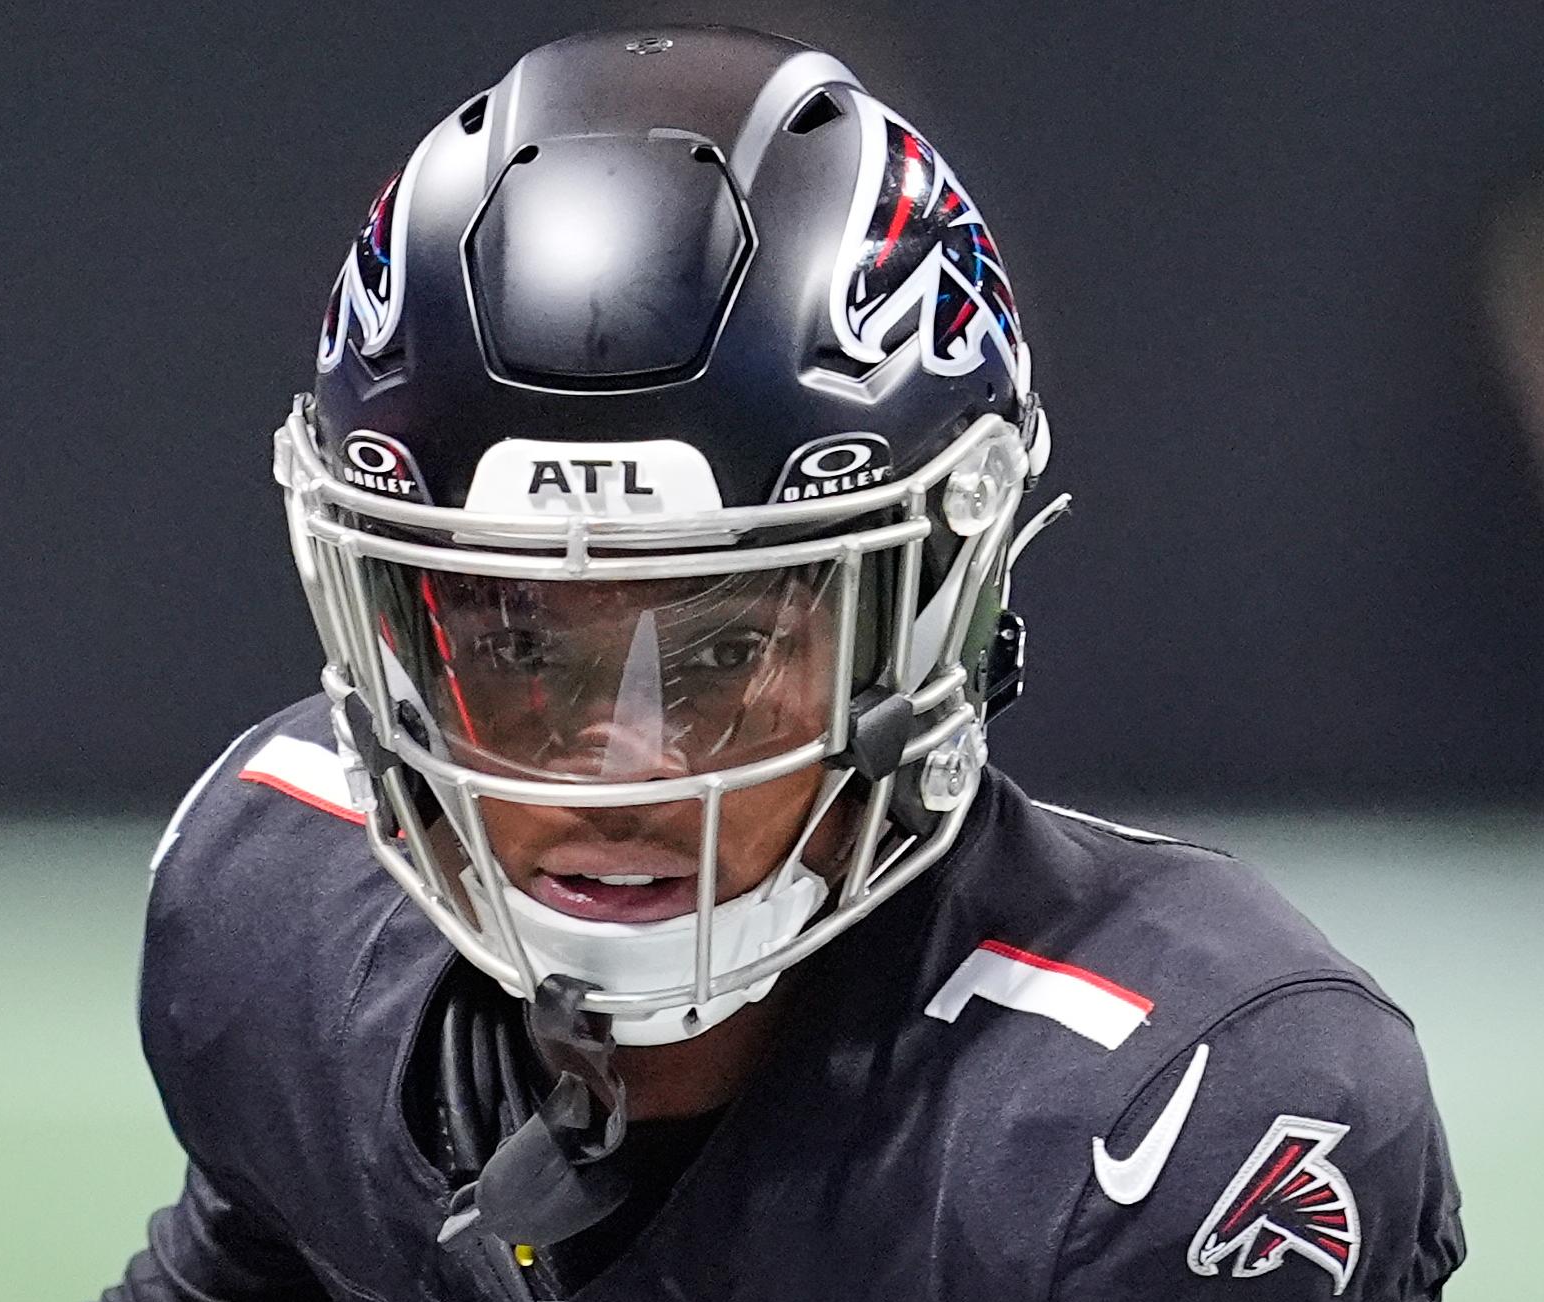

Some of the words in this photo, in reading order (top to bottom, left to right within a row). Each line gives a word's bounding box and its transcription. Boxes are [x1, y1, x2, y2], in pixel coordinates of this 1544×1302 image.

[343, 467, 412, 495] OAKLEY
[528, 460, 654, 494] ATL
[783, 465, 890, 502] OAKLEY
